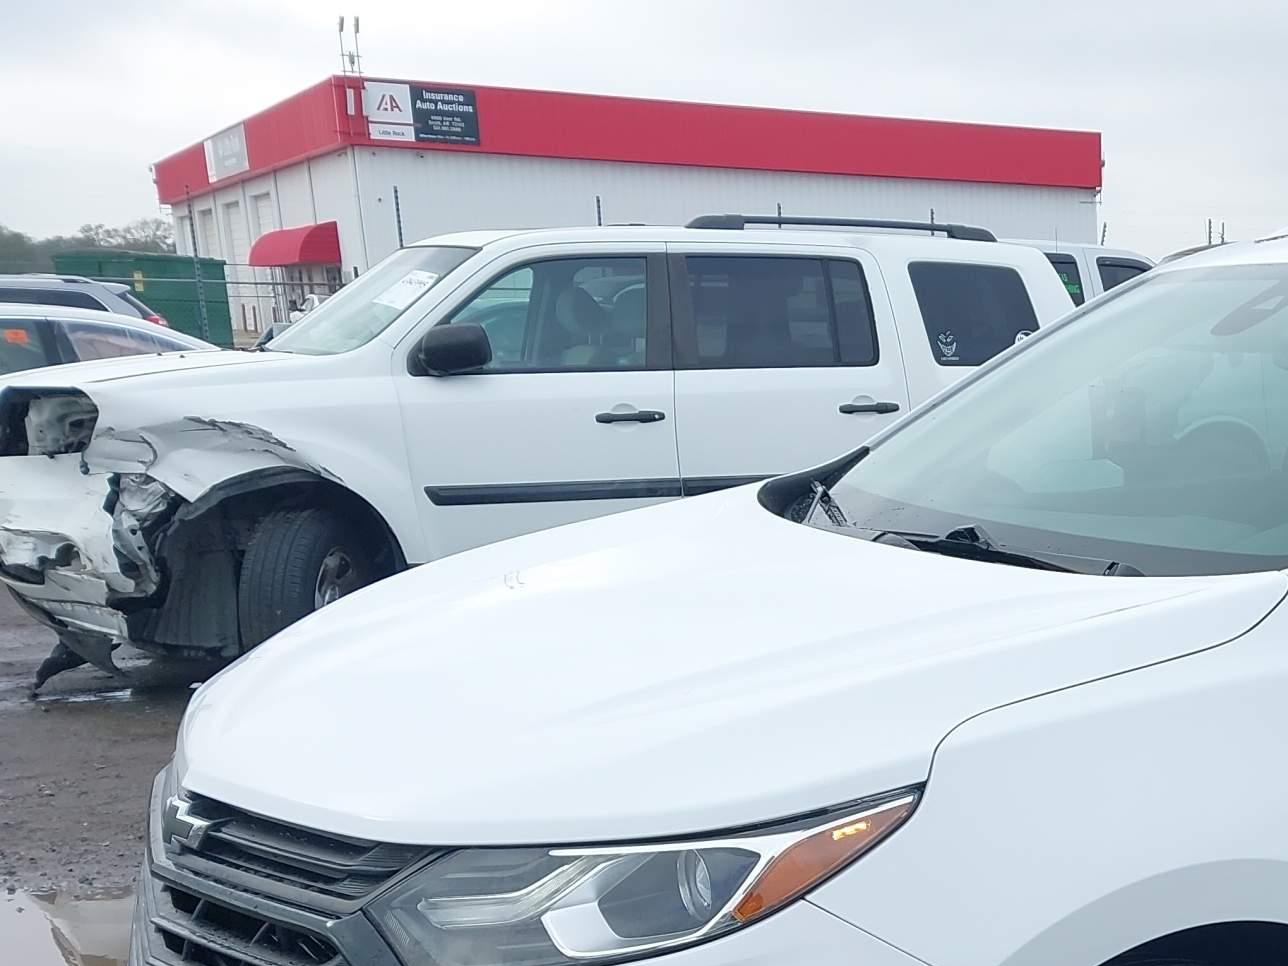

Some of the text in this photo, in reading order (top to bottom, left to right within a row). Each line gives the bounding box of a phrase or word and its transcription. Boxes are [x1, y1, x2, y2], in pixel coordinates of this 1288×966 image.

[422, 90, 464, 101] Insurance
[415, 99, 474, 112] Auto Auctions
